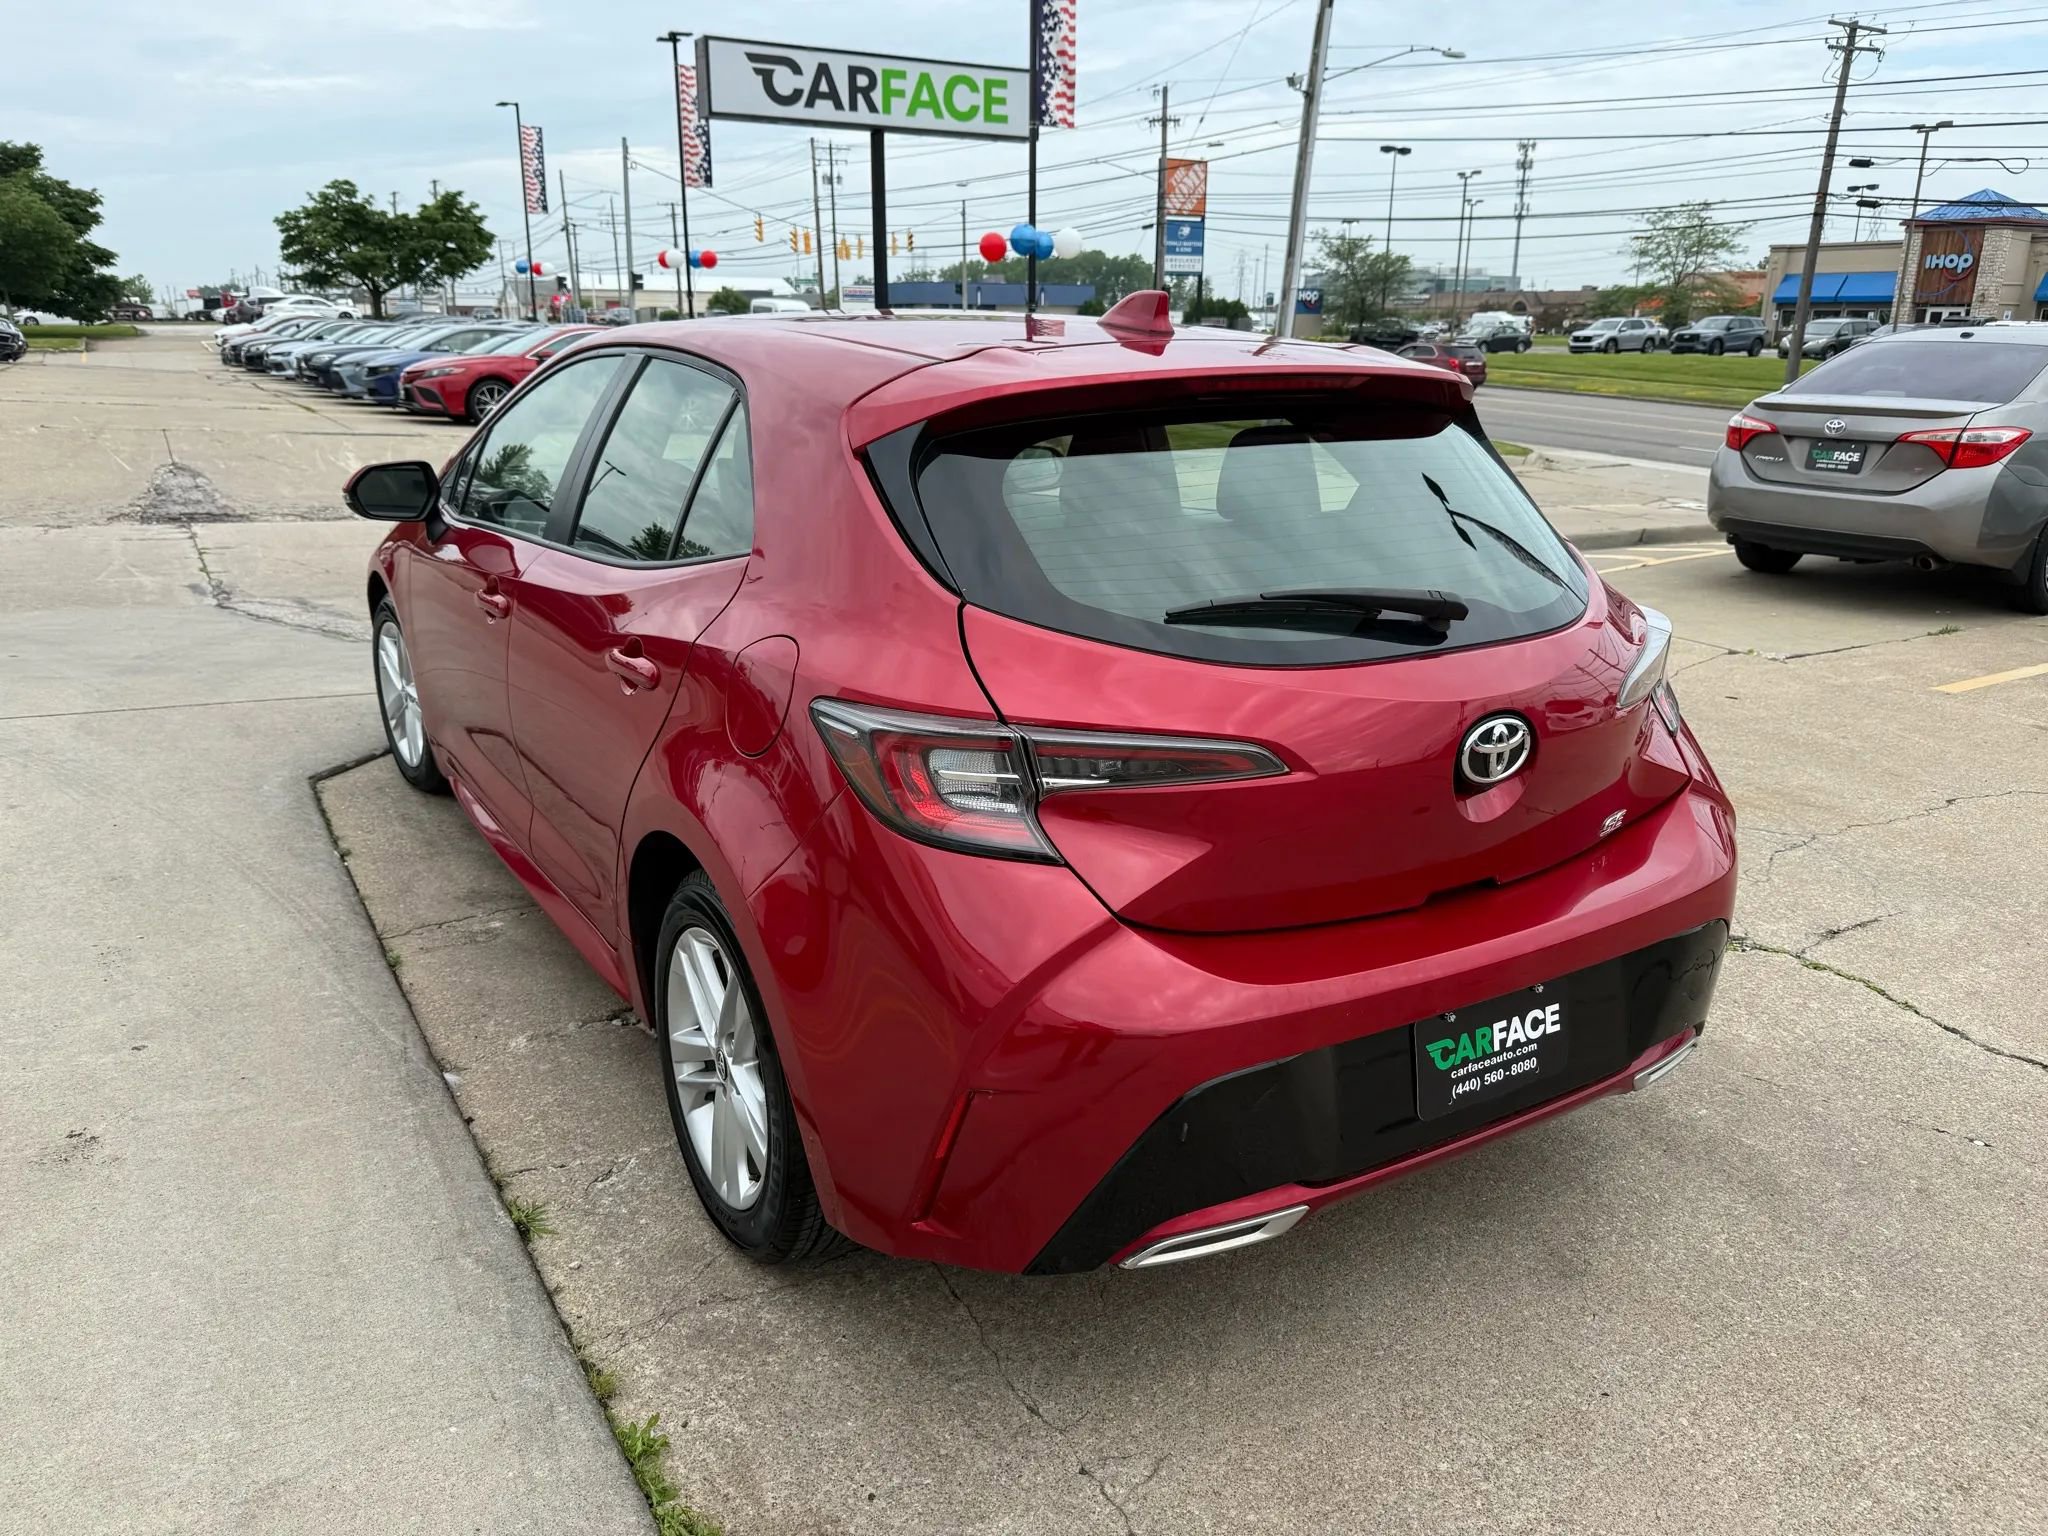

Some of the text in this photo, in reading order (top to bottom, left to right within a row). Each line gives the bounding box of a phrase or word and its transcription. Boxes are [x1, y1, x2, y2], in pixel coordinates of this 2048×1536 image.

[744, 52, 1008, 124] CARFACE
[1925, 253, 1973, 273] IHOP
[1298, 290, 1319, 304] HOP
[1811, 449, 1861, 462] CARFACE
[1426, 1003, 1561, 1070] CARFACE
[1451, 1042, 1538, 1079] carfaceauto.com
[1452, 1077, 1481, 1099] (440)
